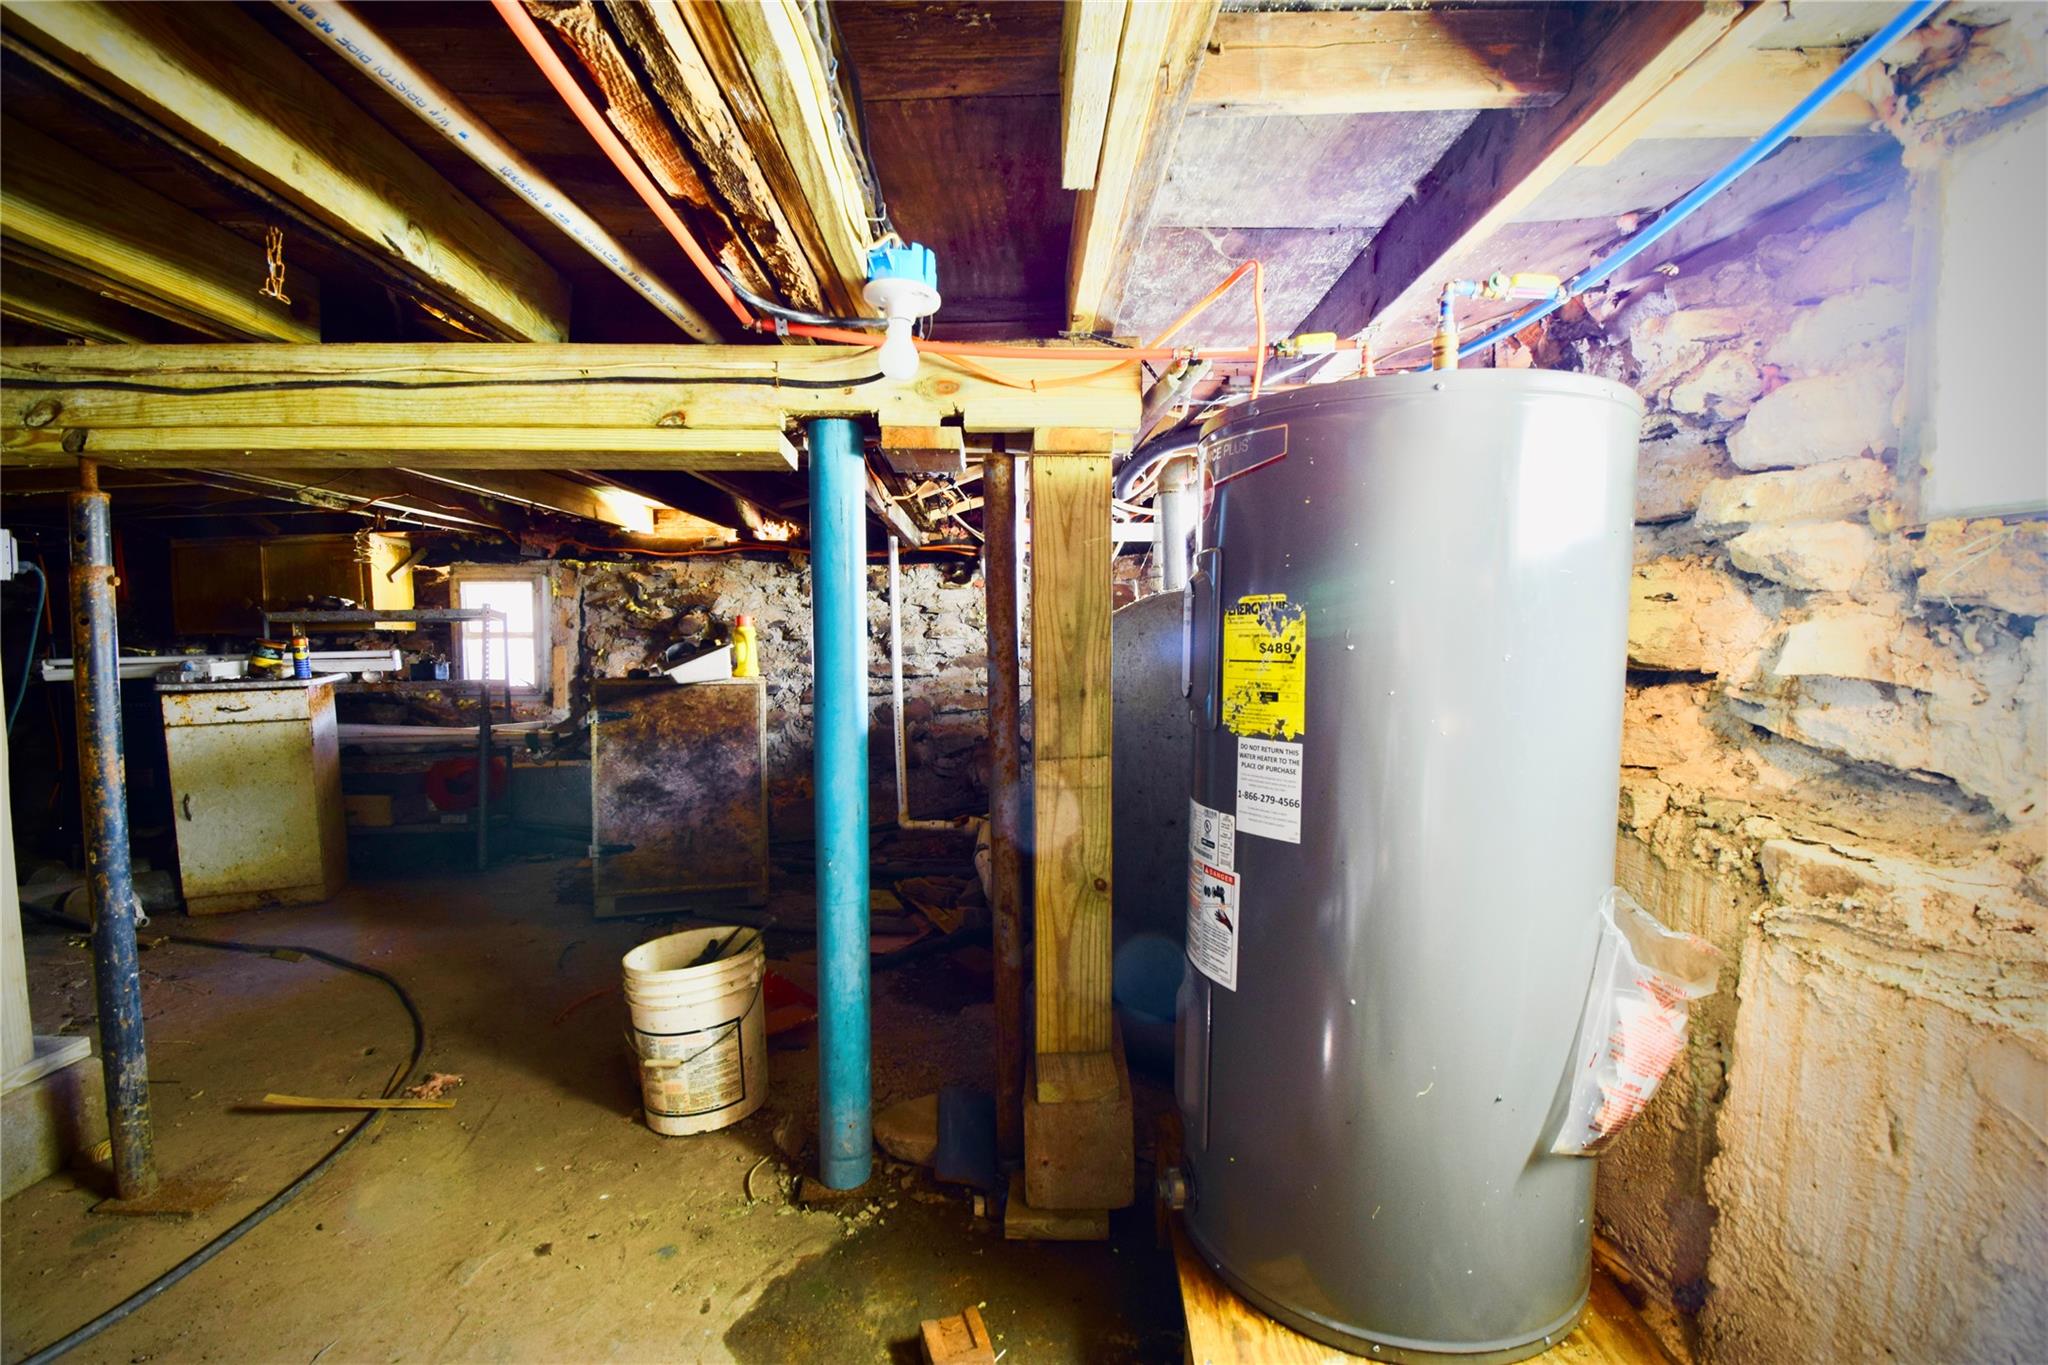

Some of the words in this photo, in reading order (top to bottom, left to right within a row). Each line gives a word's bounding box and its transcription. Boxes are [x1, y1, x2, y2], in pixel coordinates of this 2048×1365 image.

[1223, 438, 1249, 457] PLUS
[1259, 642, 1292, 654] $489
[1261, 746, 1284, 755] RETURN
[1285, 749, 1300, 757] THIS
[1240, 752, 1256, 760] WATER
[1257, 755, 1278, 763] HEATER
[1279, 757, 1288, 765] TO
[1241, 761, 1256, 770] PLACE
[1265, 765, 1297, 775] PURCHASE
[1238, 789, 1300, 808] 1-866-279-4566
